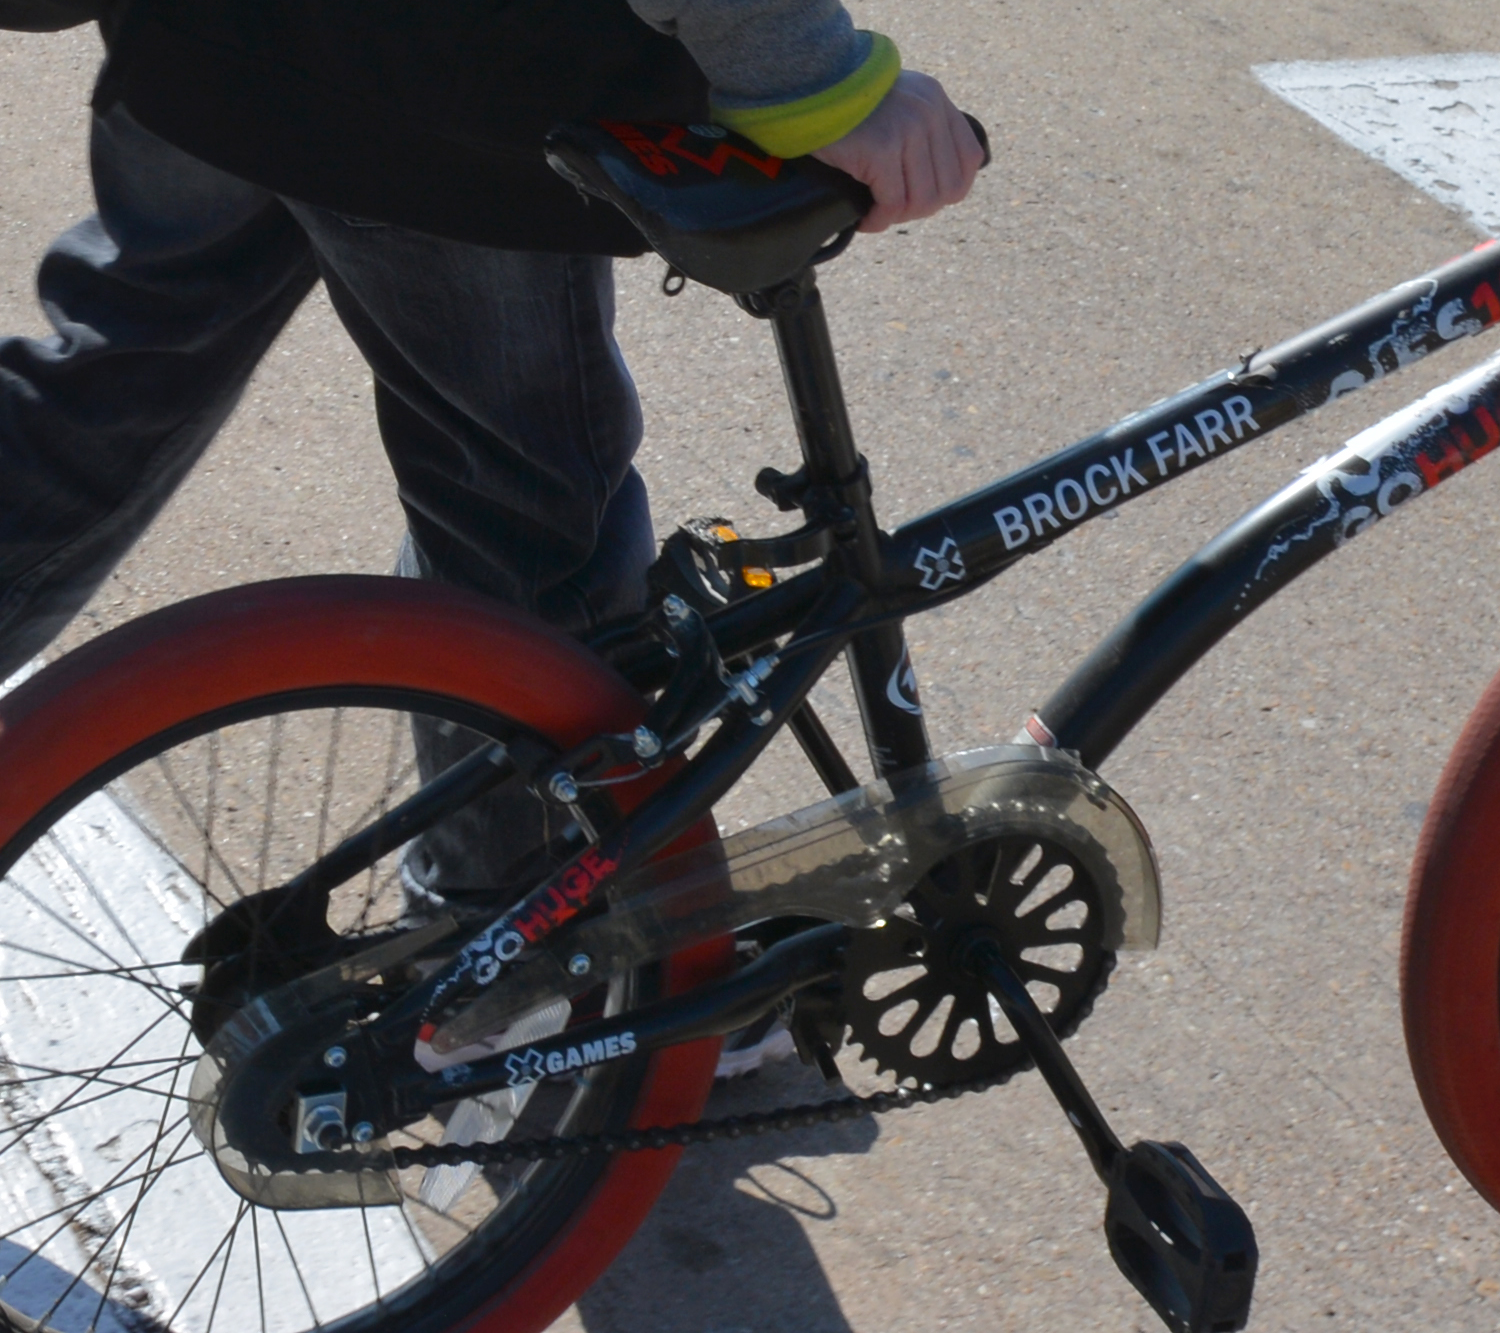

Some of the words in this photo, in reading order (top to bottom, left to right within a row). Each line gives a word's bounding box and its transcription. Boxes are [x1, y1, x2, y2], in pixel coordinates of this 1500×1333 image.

[992, 447, 1149, 551] BROCK
[1145, 394, 1261, 477] FARR
[546, 1031, 638, 1074] GAMES
